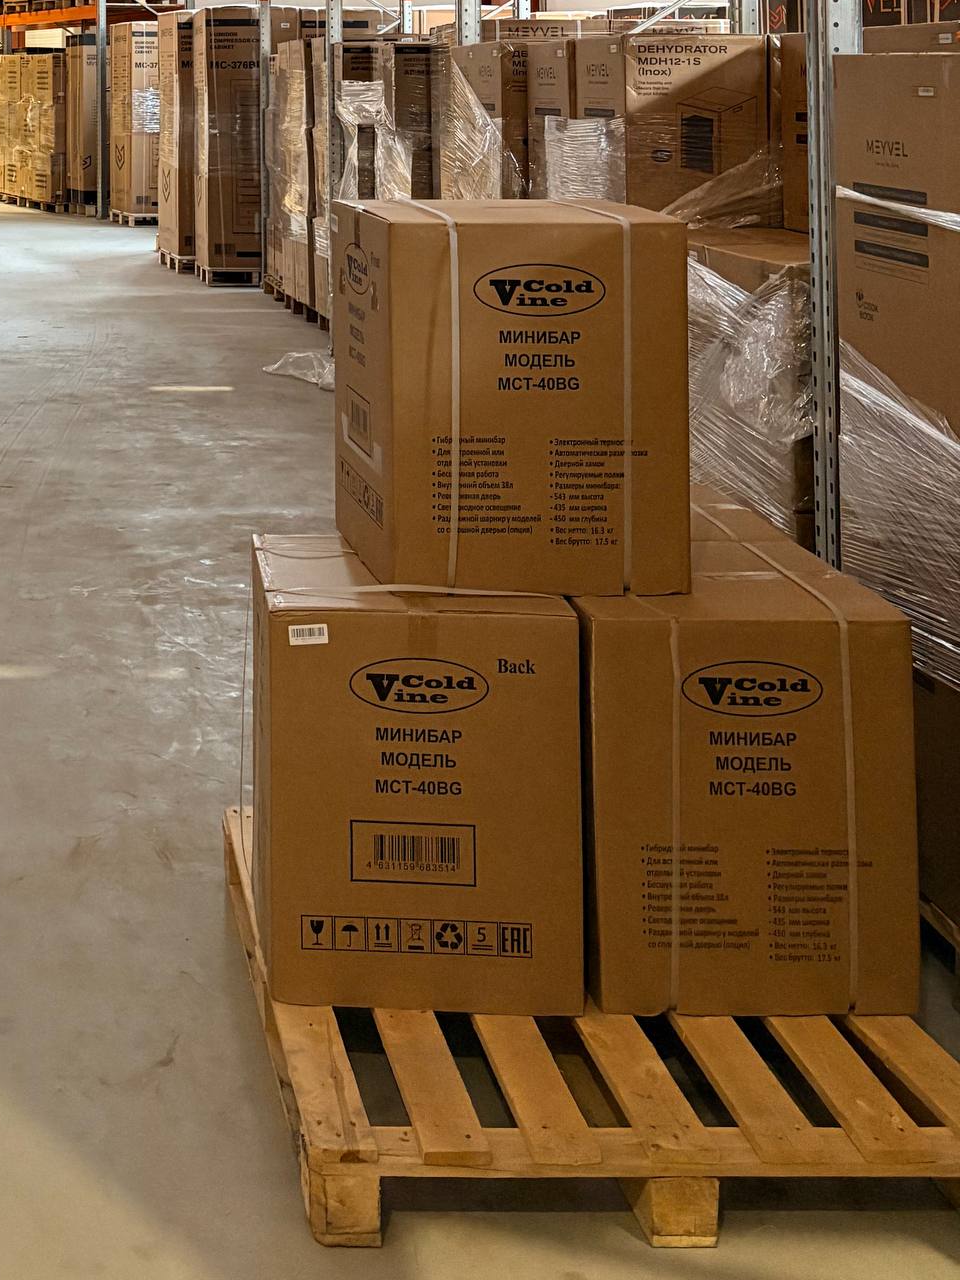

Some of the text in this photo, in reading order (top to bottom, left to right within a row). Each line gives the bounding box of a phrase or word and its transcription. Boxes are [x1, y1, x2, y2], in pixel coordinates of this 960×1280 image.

[508, 26, 569, 37] MEYVEL
[638, 45, 728, 54] DEHYDRATOR
[638, 67, 672, 77] (Inox)
[866, 140, 908, 157] MEYVEL
[489, 279, 567, 307] Vine
[523, 279, 594, 293] Cold
[499, 330, 581, 344] МИНИБАР
[504, 353, 575, 370] МОДЕЛЬ
[498, 377, 580, 391] MCT-40BG
[497, 658, 536, 675] Back
[366, 673, 449, 704] Vine
[401, 674, 477, 691] Cold
[734, 678, 811, 692] Cold
[698, 677, 782, 706] Vine
[375, 727, 462, 744] МИНИБАР
[709, 731, 797, 746] МИНИБАР
[381, 751, 457, 770] МОДЕЛЬ
[716, 756, 792, 773] МОДЕЛЬ
[375, 779, 462, 796] MCT-40BG
[709, 781, 797, 796] MCT-40BG
[378, 861, 415, 871] 631159
[419, 863, 456, 873] 683514
[501, 926, 531, 955] EAC
